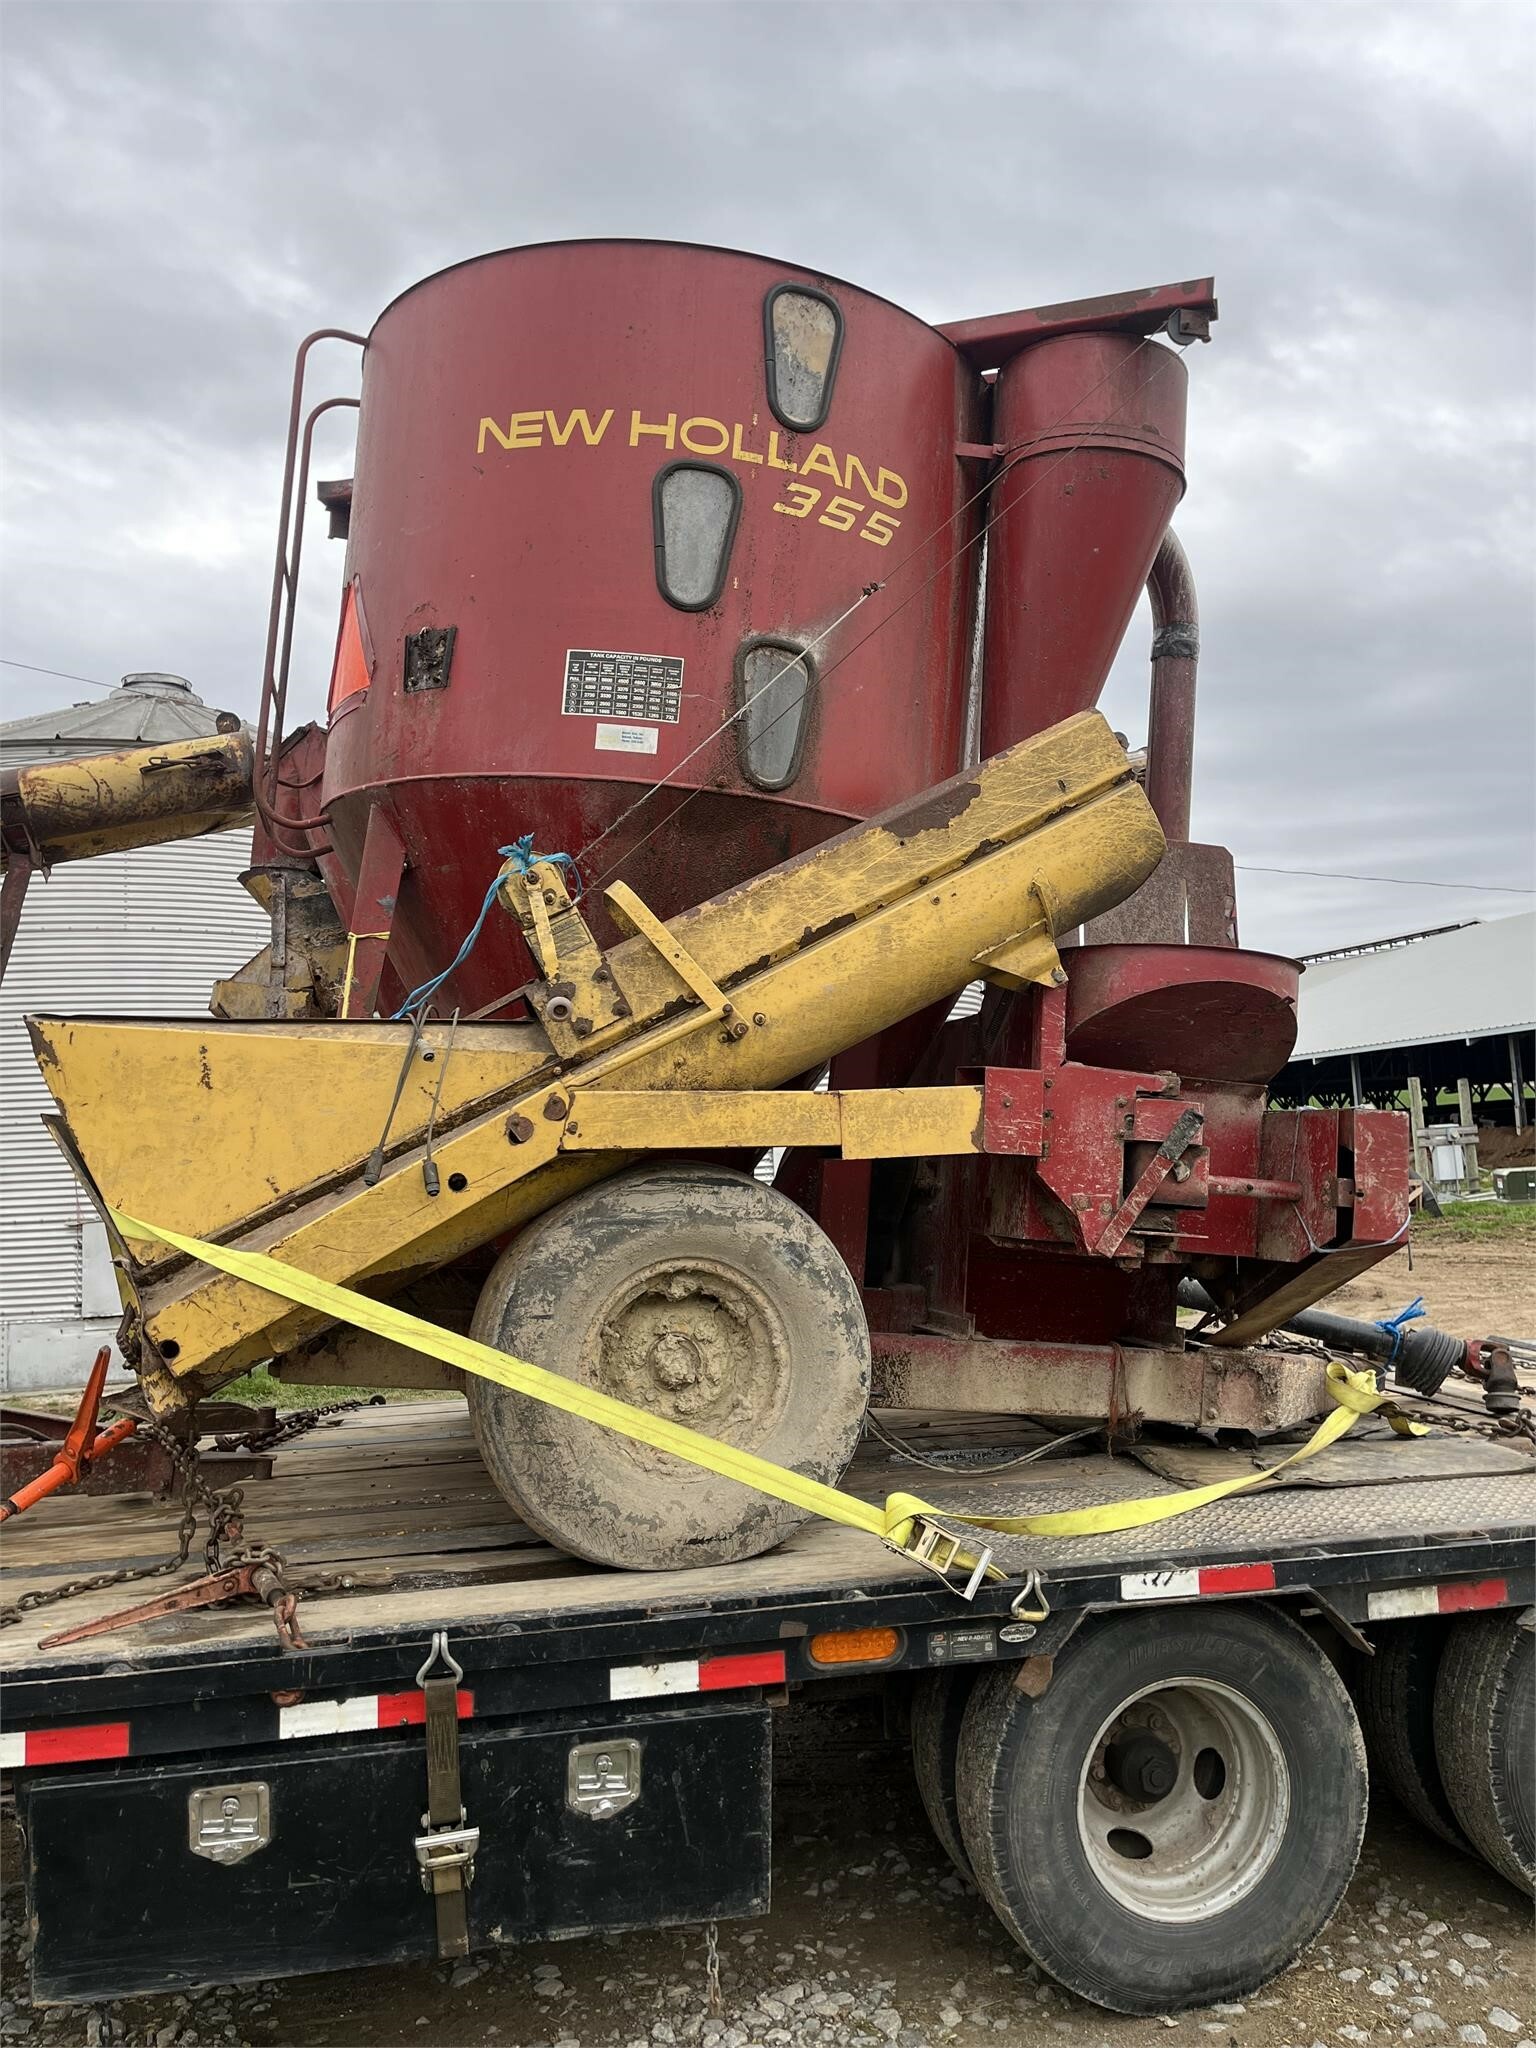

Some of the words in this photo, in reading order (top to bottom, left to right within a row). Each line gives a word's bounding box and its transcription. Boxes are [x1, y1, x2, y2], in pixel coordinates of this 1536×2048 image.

[477, 409, 614, 453] NEW
[629, 410, 909, 510] HOLLAND
[772, 482, 901, 547] 355
